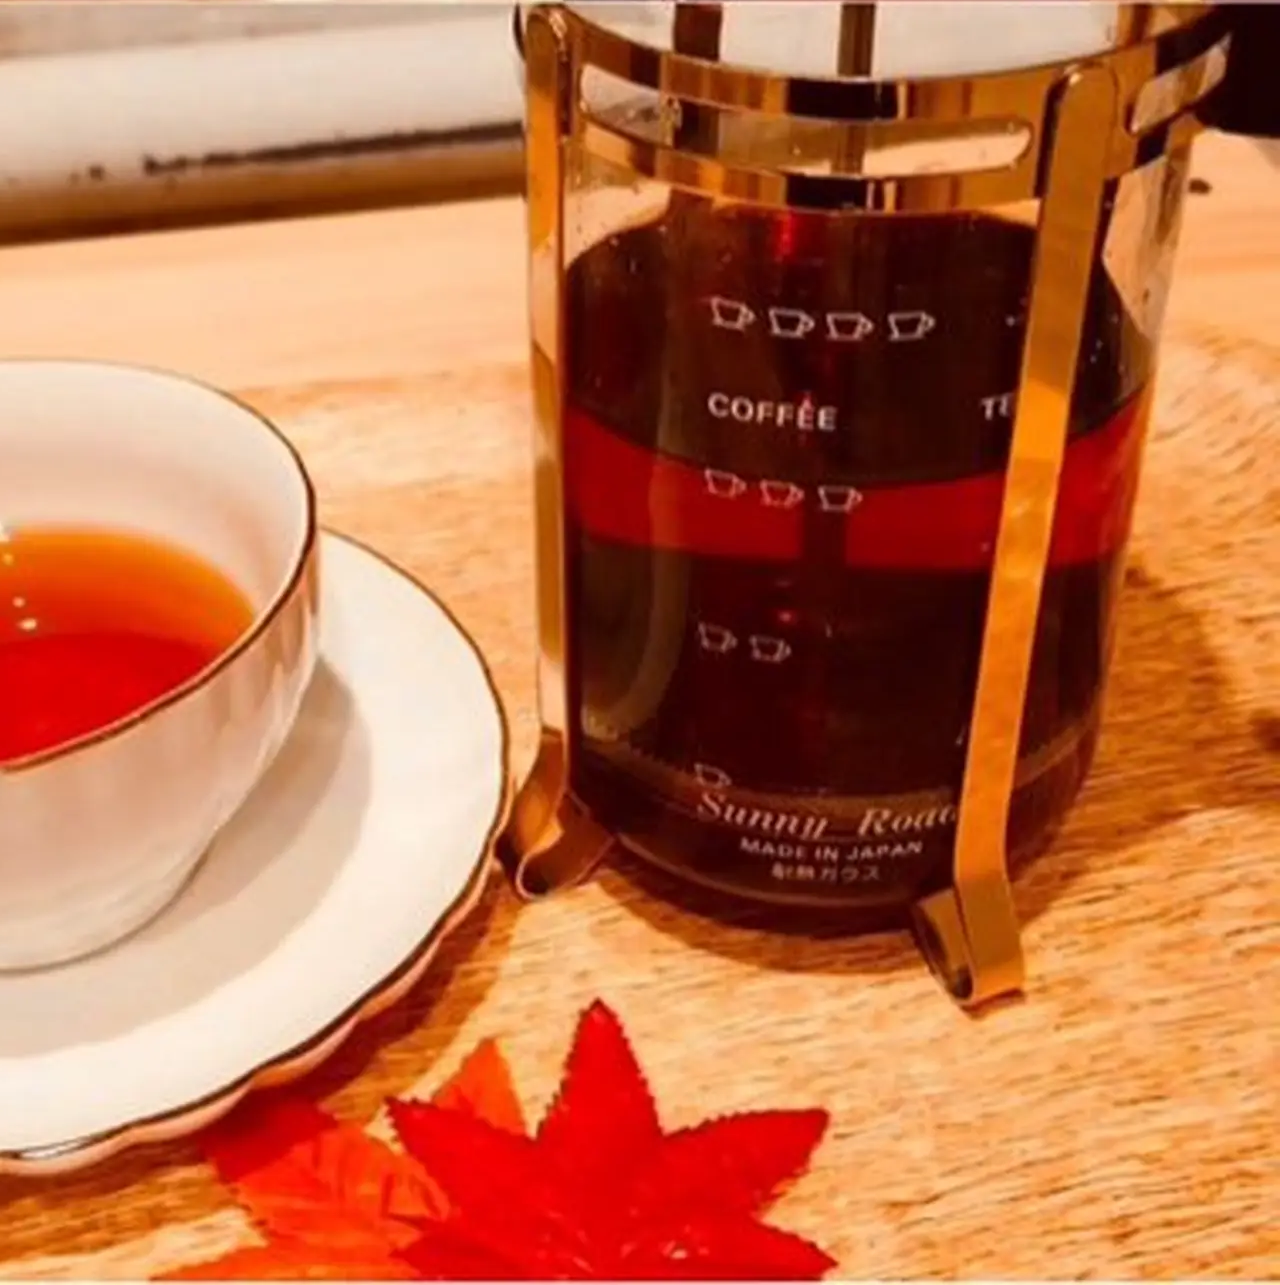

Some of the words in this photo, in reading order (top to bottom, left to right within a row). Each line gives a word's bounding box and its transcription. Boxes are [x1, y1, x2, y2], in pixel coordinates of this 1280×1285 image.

[707, 392, 838, 431] COFFEE
[981, 392, 1016, 421] TE
[697, 790, 828, 840] Sunny
[741, 837, 804, 859] MADE
[814, 845, 838, 862] IN
[846, 841, 923, 861] JAPAN
